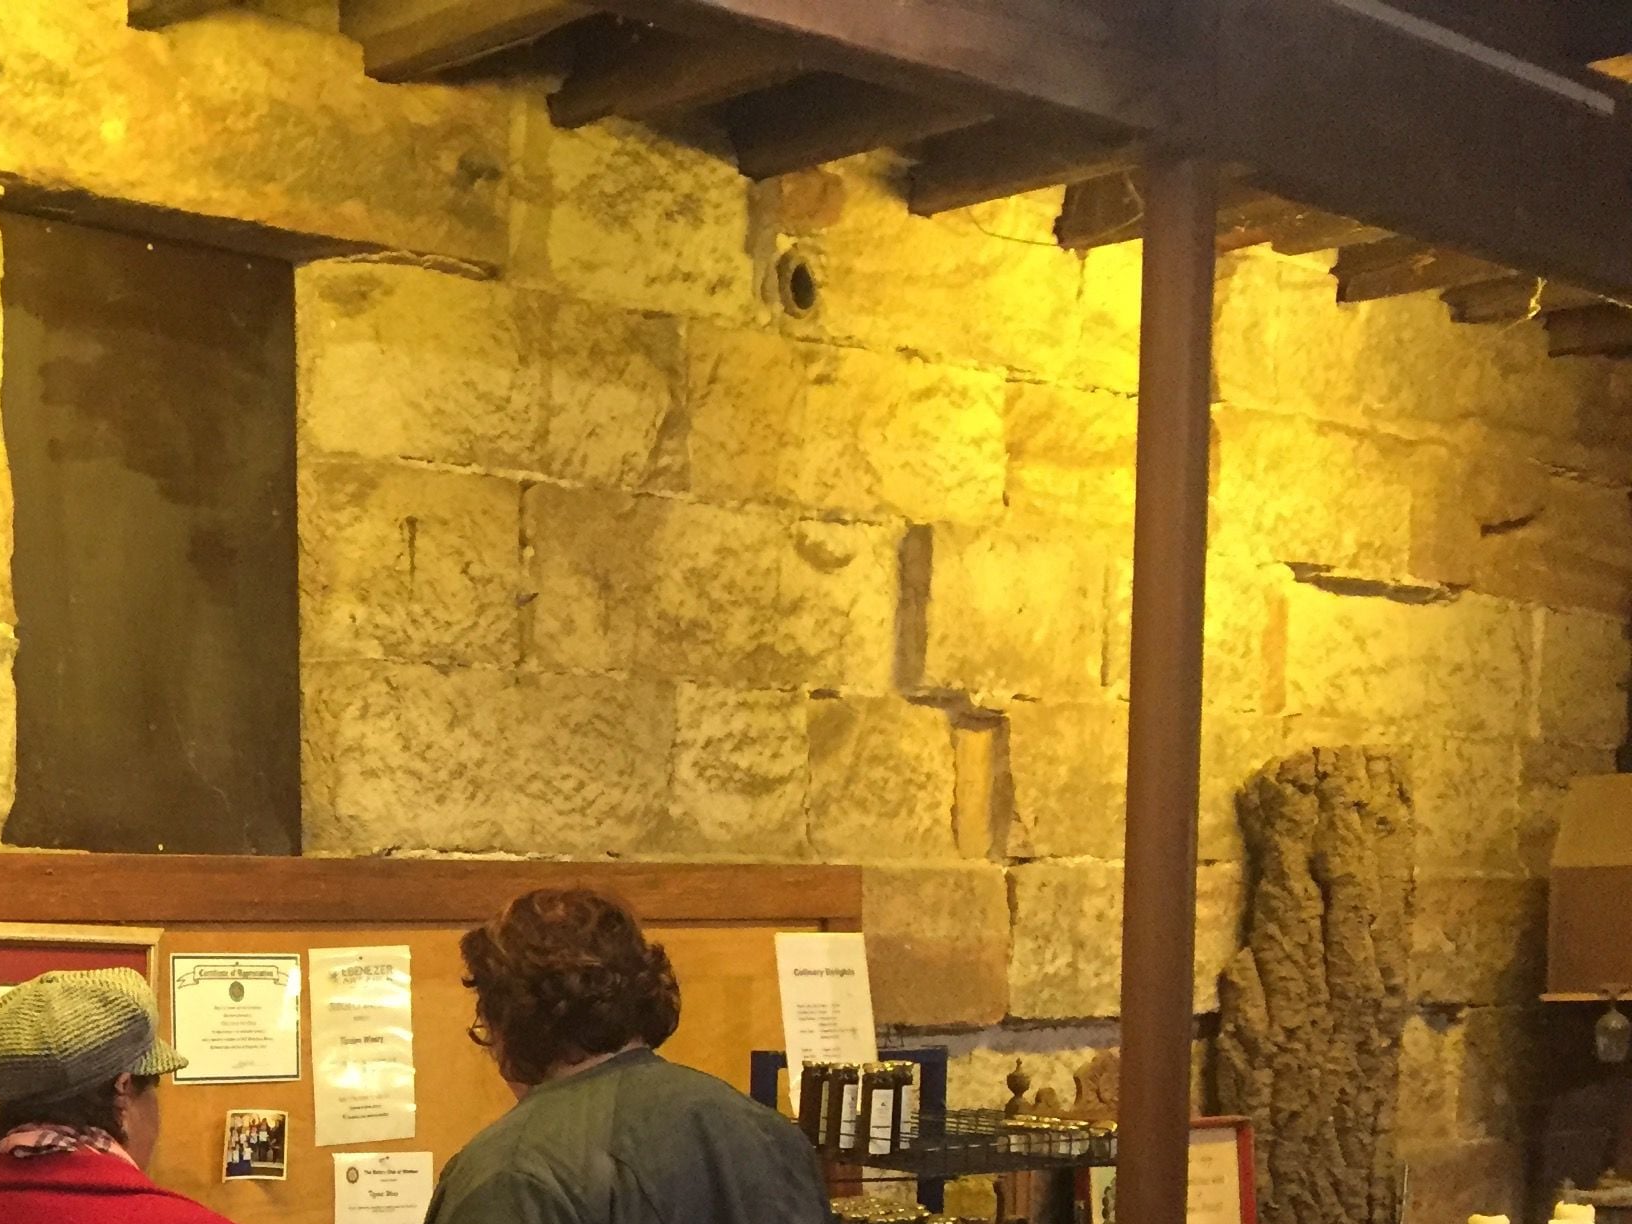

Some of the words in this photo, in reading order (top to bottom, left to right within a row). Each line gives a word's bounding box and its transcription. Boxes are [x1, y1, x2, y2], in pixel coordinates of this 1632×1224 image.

[341, 964, 393, 977] EBENEZER
[793, 968, 824, 978] Culinary
[825, 967, 855, 977] Delights
